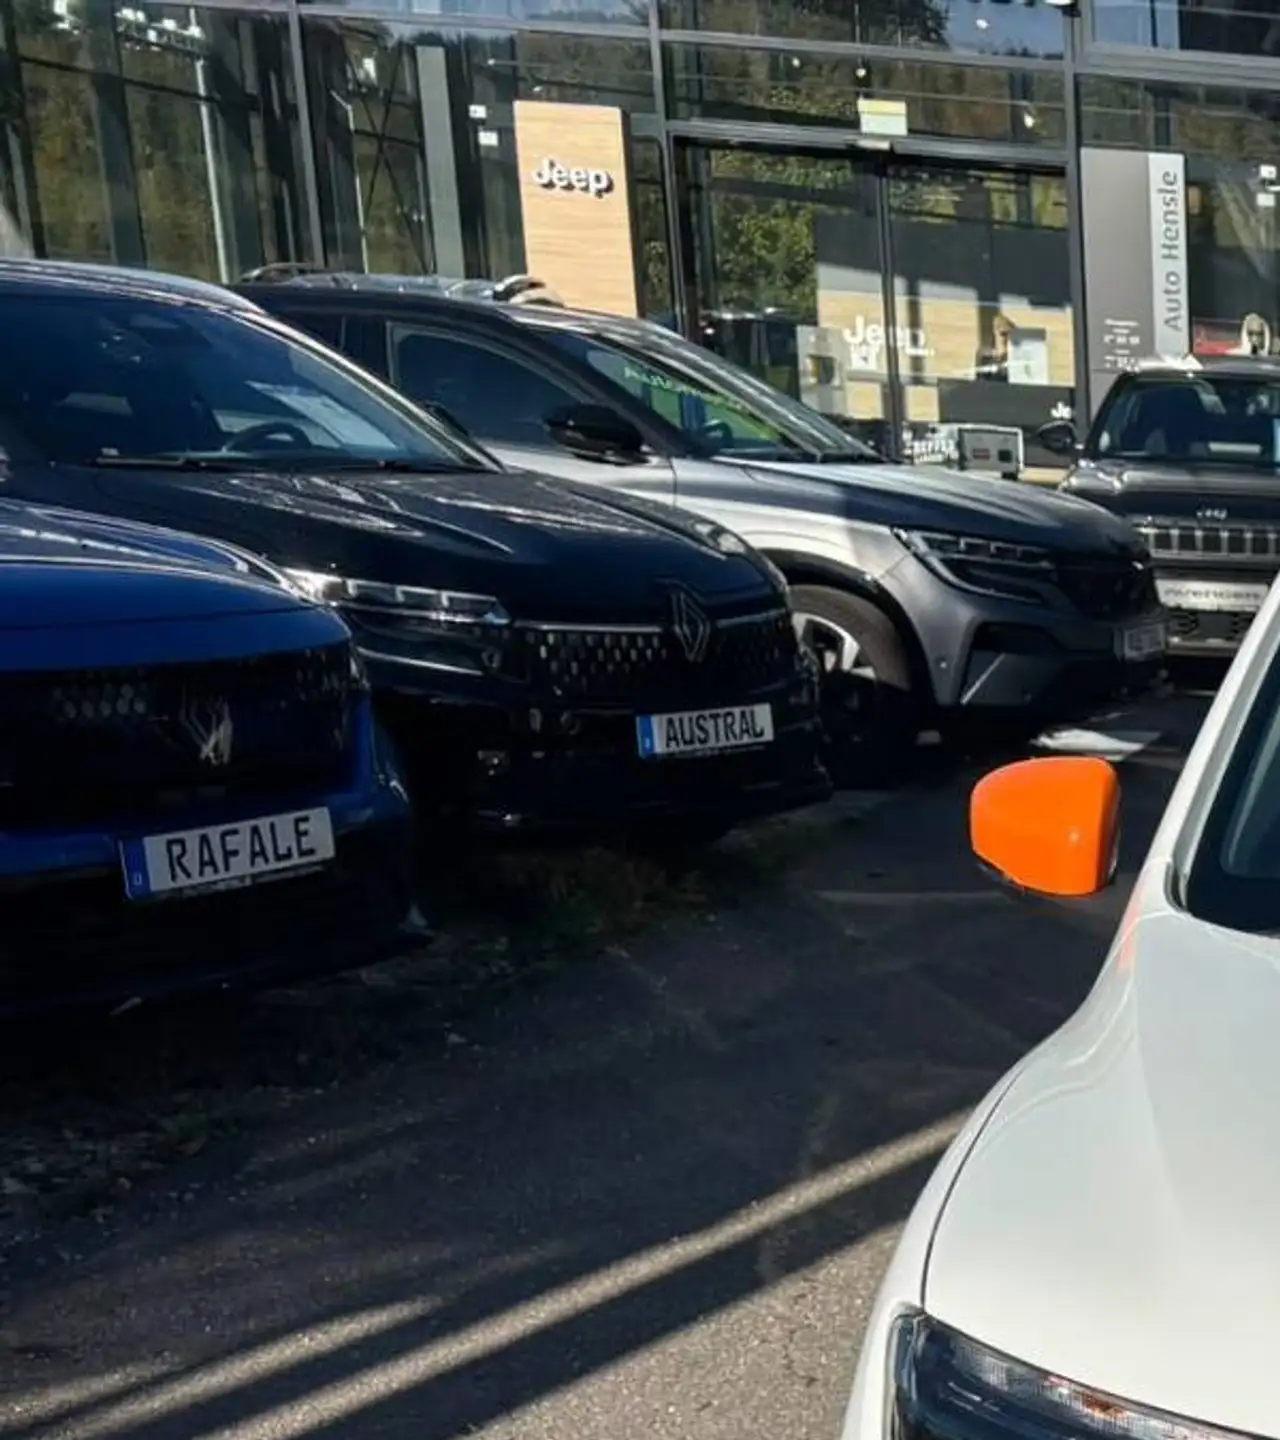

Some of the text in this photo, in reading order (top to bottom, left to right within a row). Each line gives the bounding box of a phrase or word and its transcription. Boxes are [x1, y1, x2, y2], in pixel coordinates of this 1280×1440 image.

[531, 159, 609, 197] Jeep
[1157, 170, 1181, 332] Auto Hensle
[665, 709, 765, 748] AUSTRAL
[166, 815, 316, 882] RAFALE
